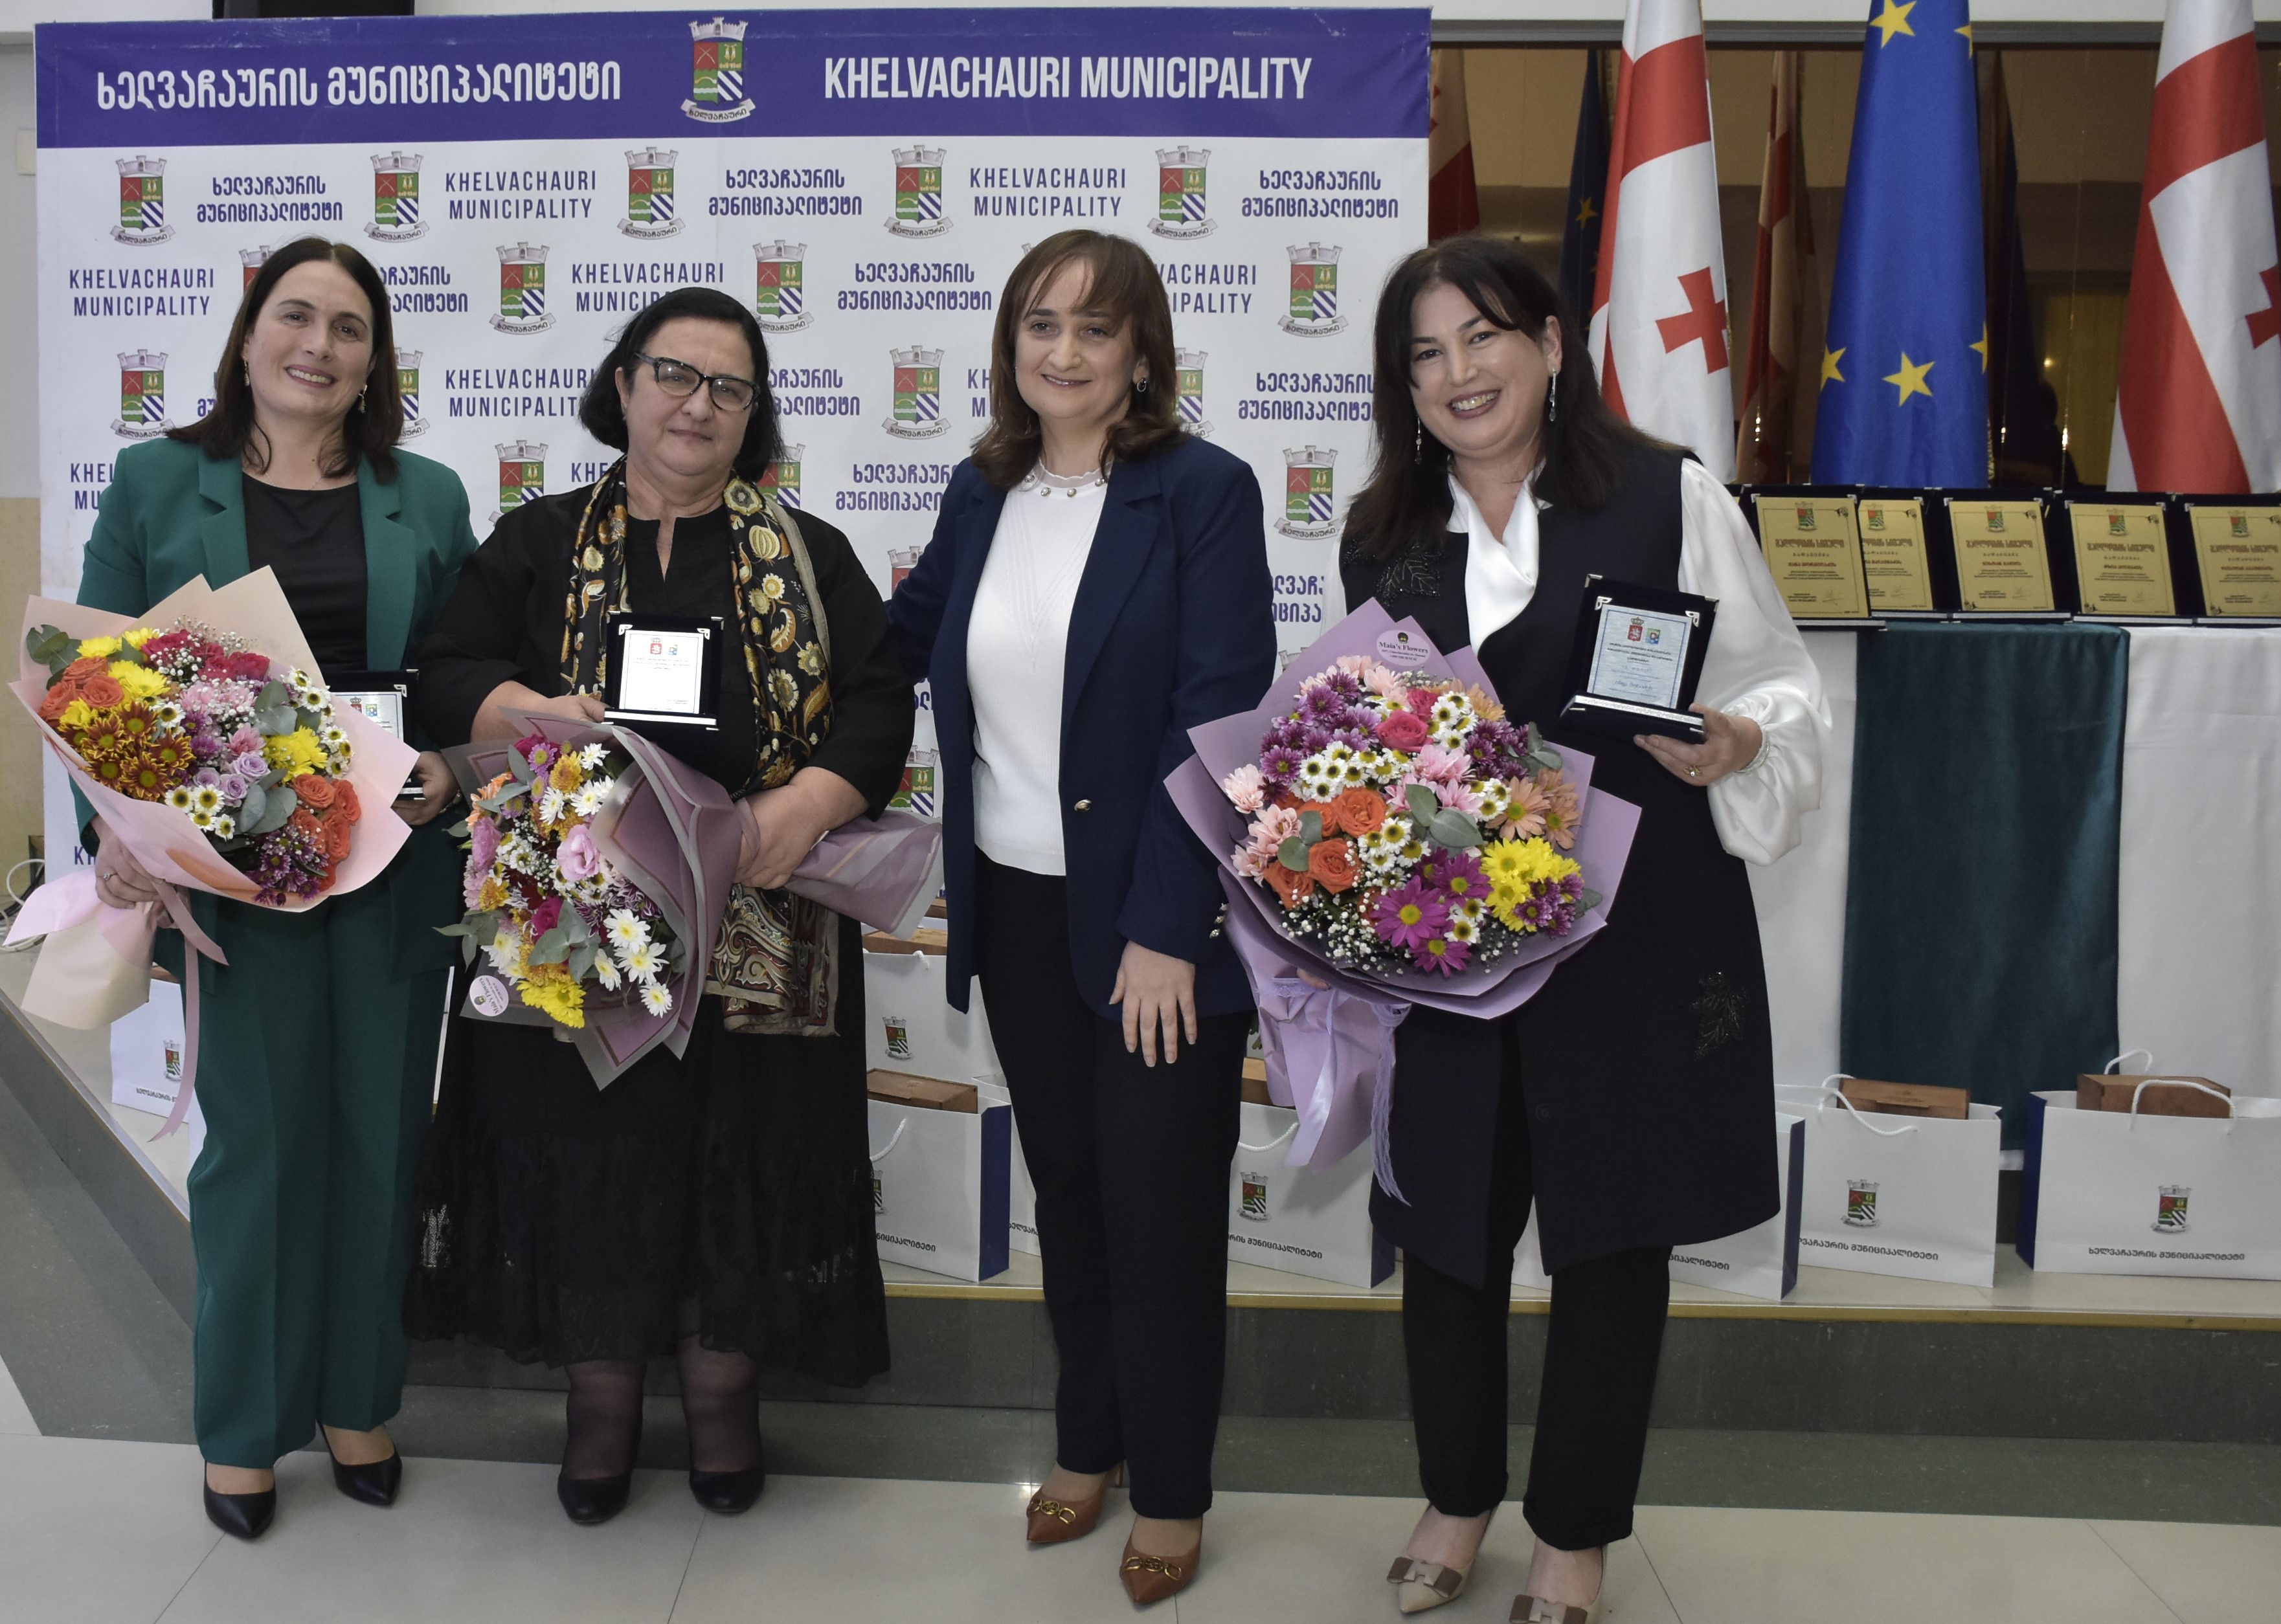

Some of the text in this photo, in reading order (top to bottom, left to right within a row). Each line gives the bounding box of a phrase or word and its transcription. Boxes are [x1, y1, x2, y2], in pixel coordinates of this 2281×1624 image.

[98, 61, 620, 109] ხელვაჩაურის მუნიციპალიტეტი
[826, 57, 1312, 98] KHELVACHAURI MUNICIPALITY
[213, 175, 326, 195] ხელვაჩაურის
[446, 171, 595, 192] KHELVACHAURI
[726, 169, 844, 188] ხელვაჩაურის
[971, 168, 1125, 188] KHELVACHAURI
[1260, 170, 1380, 190] ხელვაჩაურის
[197, 202, 342, 223] მუნიციპალიტეტი
[450, 199, 591, 219] MUNICIPALITY
[709, 196, 862, 216] მუნიციპალიტეტი
[974, 196, 1121, 216] MUNICIPALITY
[1242, 197, 1398, 218] მუნიციპალიტეტი
[70, 269, 213, 289] KHELVACHAURI
[379, 265, 451, 285] აჩაურის
[572, 263, 723, 284] KHELVACHAURI
[855, 263, 974, 282] ხელვაჩაურის
[1160, 265, 1257, 285] VACHAURI
[74, 296, 209, 316] MUNICIPALITY
[576, 291, 657, 312] MUNICIP
[838, 291, 991, 310] მუნიციპალიტეტი
[1173, 293, 1252, 313] IPALITY
[446, 368, 588, 390] KHELVACHAUR
[769, 369, 843, 388] აჩაურის
[449, 395, 575, 417] MUNICIPALIT
[1239, 399, 1373, 420] მუნიციპალიტე
[853, 464, 955, 484] ხელვაჩაურ
[836, 491, 942, 511] მუნიციპალი
[1402, 645, 1428, 653] Flowers
[876, 1232, 936, 1252] ნიციპალიტეტი
[1247, 1236, 1322, 1259] მუნიციპალიტეტი
[1799, 1238, 1938, 1260] ვაჩაურის მუნიციპალიტეტი
[2089, 1247, 2245, 1260] ხელვაჩაურის მუნიციპალიტეტი
